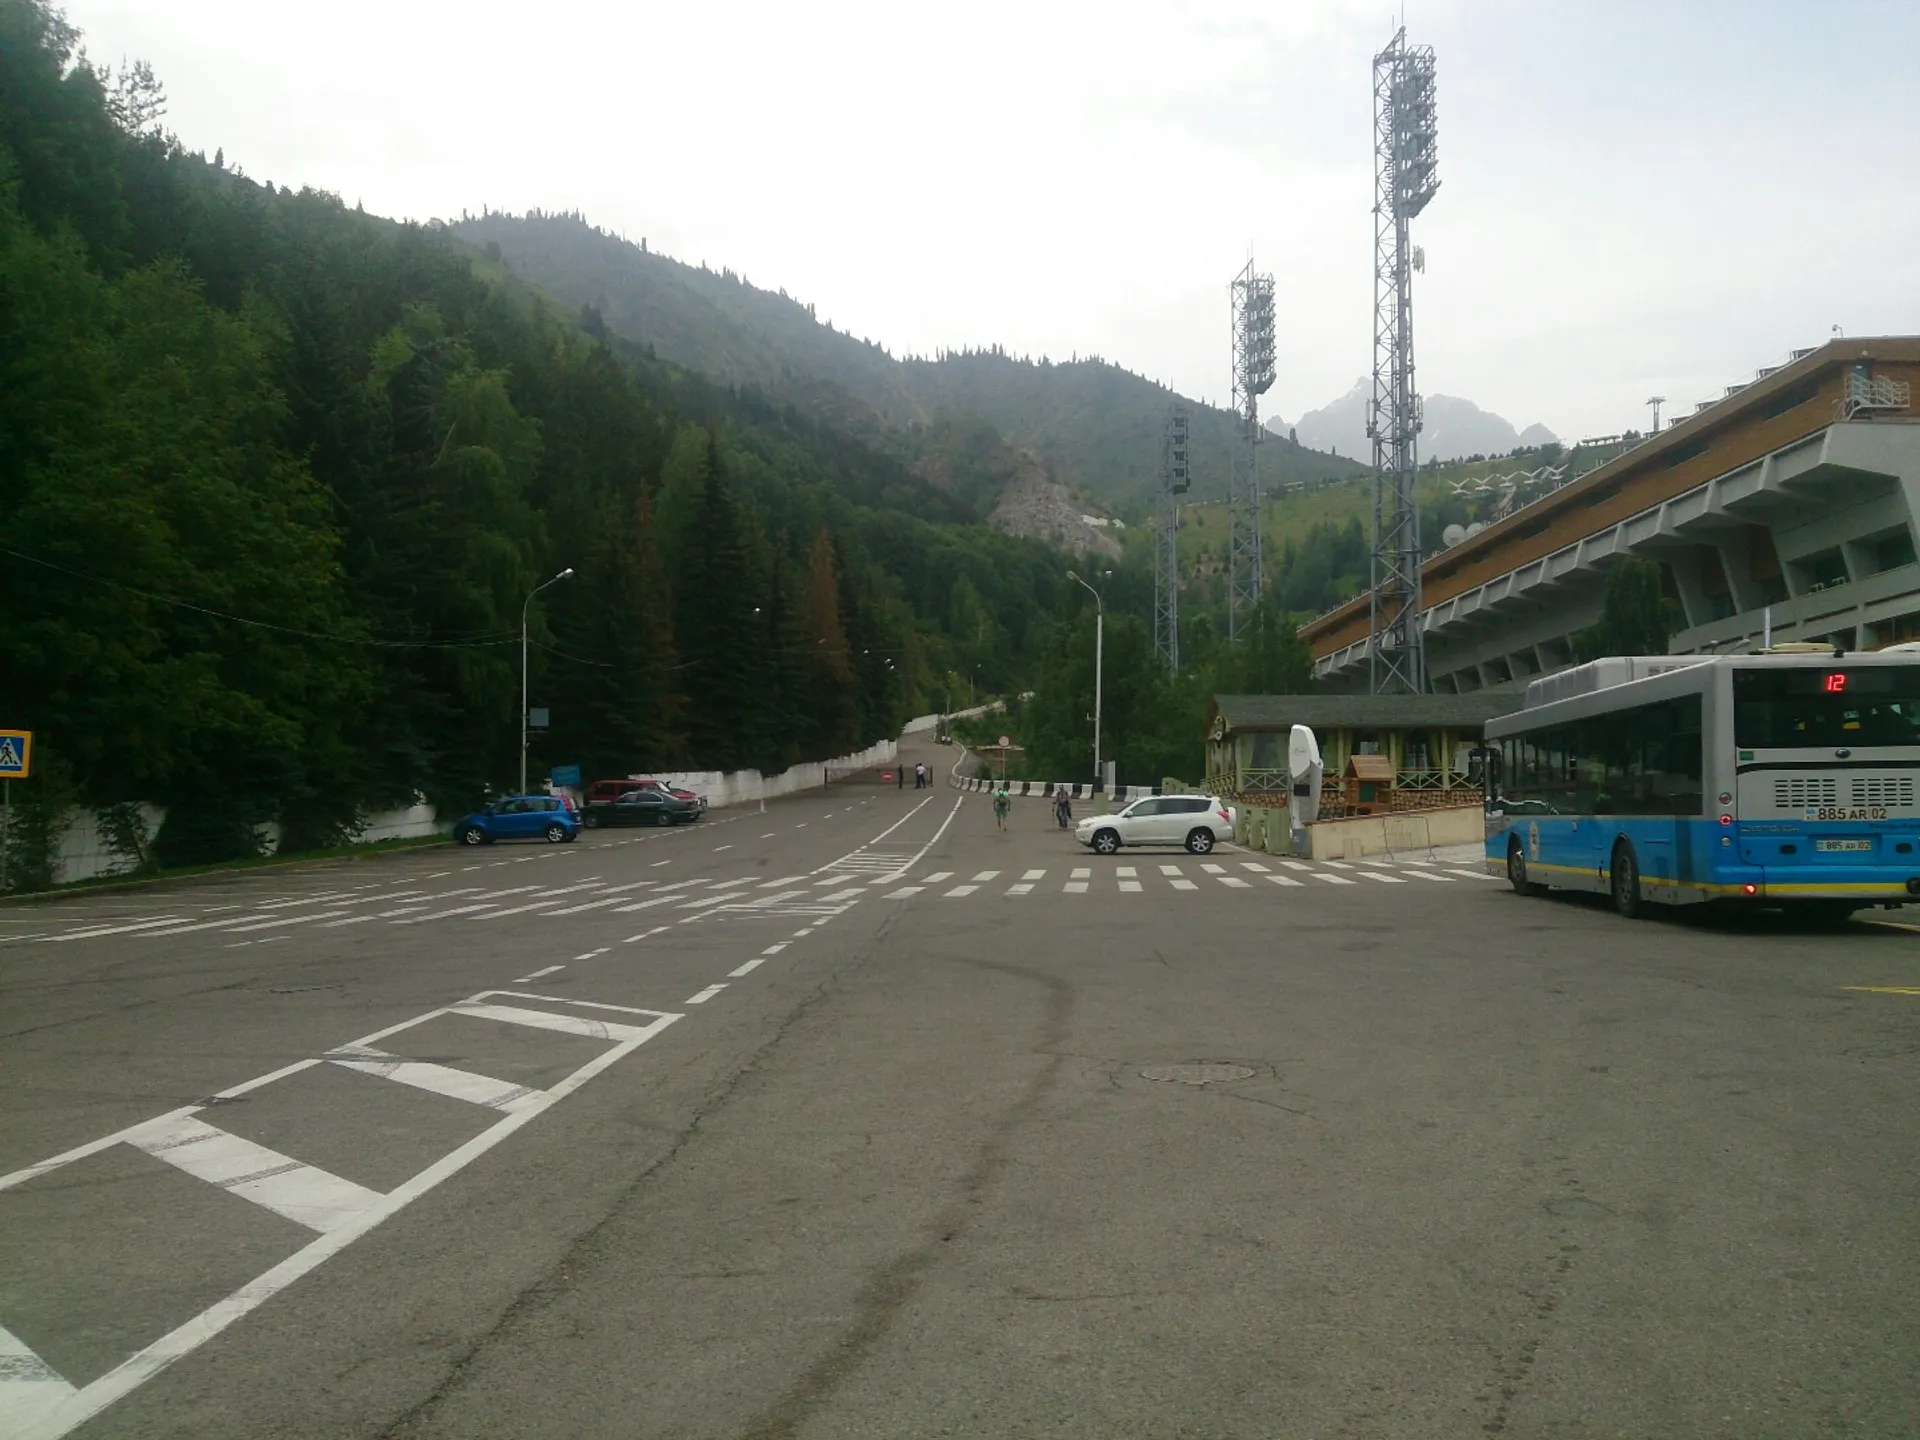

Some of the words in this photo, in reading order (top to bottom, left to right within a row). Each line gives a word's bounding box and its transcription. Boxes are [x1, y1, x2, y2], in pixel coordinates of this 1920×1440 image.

[1827, 674, 1845, 691] 12
[1818, 808, 1846, 820] 885
[1850, 809, 1868, 820] AR
[1872, 808, 1887, 819] 02
